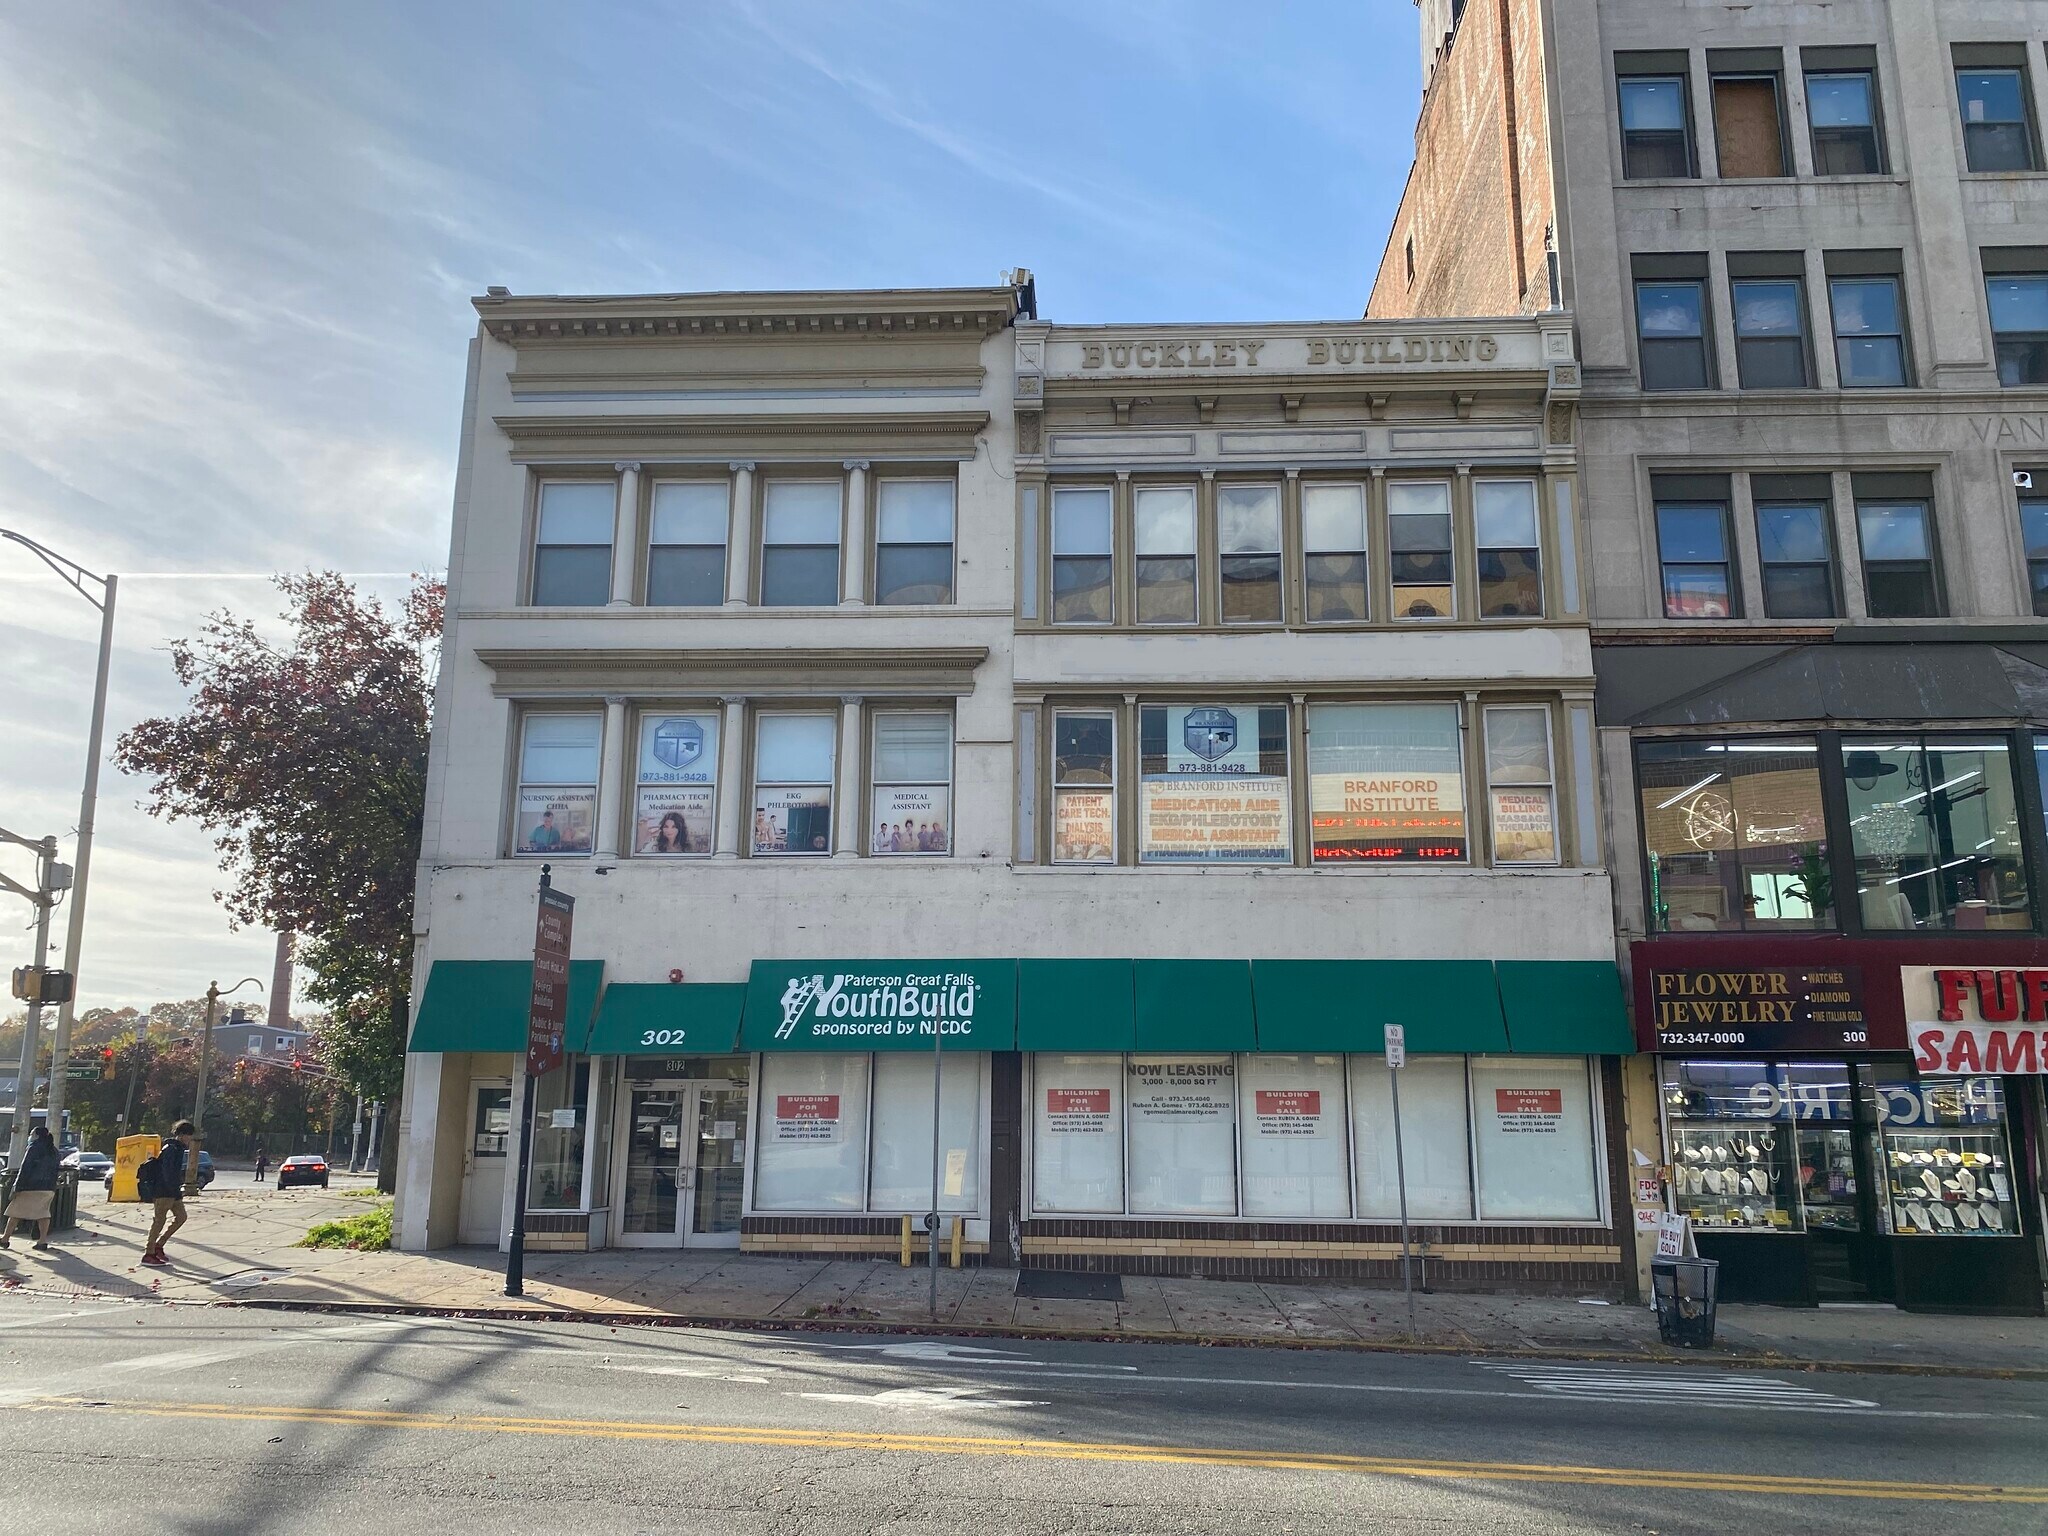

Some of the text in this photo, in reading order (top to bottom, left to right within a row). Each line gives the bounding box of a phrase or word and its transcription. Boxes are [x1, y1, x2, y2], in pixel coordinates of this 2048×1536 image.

[1082, 334, 1498, 369] BUCKLEY BUILDING
[1968, 417, 2045, 443] VAN
[1178, 763, 1246, 772] 973-881-9428
[642, 773, 708, 781] 973-881-9428
[1167, 782, 1282, 793] BRANFORD INSTITUTE
[1344, 780, 1438, 794] BRANFORD
[1066, 796, 1103, 807] PATIENT
[1151, 798, 1280, 812] MEDICATION AIDE
[1344, 797, 1440, 812] INSTITUTE
[1498, 795, 1546, 804] MEDICAL
[1058, 808, 1110, 818] CARE TECH.
[1501, 805, 1544, 813] BILLING
[1149, 813, 1283, 827] EKG/PHLEBOTOMY
[1496, 814, 1550, 823] MASSAGE
[1066, 822, 1103, 833] DIALYSIS
[1152, 829, 1280, 842] MEDICAL ASSISTANT
[1147, 844, 1285, 858] PHARMACY TECHNICIAN
[844, 973, 975, 986] Paterson Great Falls
[1657, 973, 1791, 996] FLOWER
[1808, 972, 1844, 984] WATCHES
[811, 974, 974, 1018] YouthBuild
[1810, 991, 1851, 1003] DIAMOND
[1656, 1000, 1797, 1030] JEWELRY
[1812, 1010, 1863, 1022] FINE ITALIAN GOLD
[812, 1020, 972, 1036] sponsored by NJCDC
[530, 1031, 550, 1046] Parking
[640, 1029, 686, 1046] 302
[1660, 1032, 1745, 1044] 732-347-0000
[1843, 1031, 1867, 1042] 300
[1915, 1030, 2048, 1073] SAM
[666, 1060, 685, 1071] 302
[1127, 1065, 1235, 1076] NOW LEASING
[1639, 1180, 1658, 1191] FDC
[1660, 1228, 1680, 1243] WE BUY
[1660, 1241, 1676, 1255] GOLD
